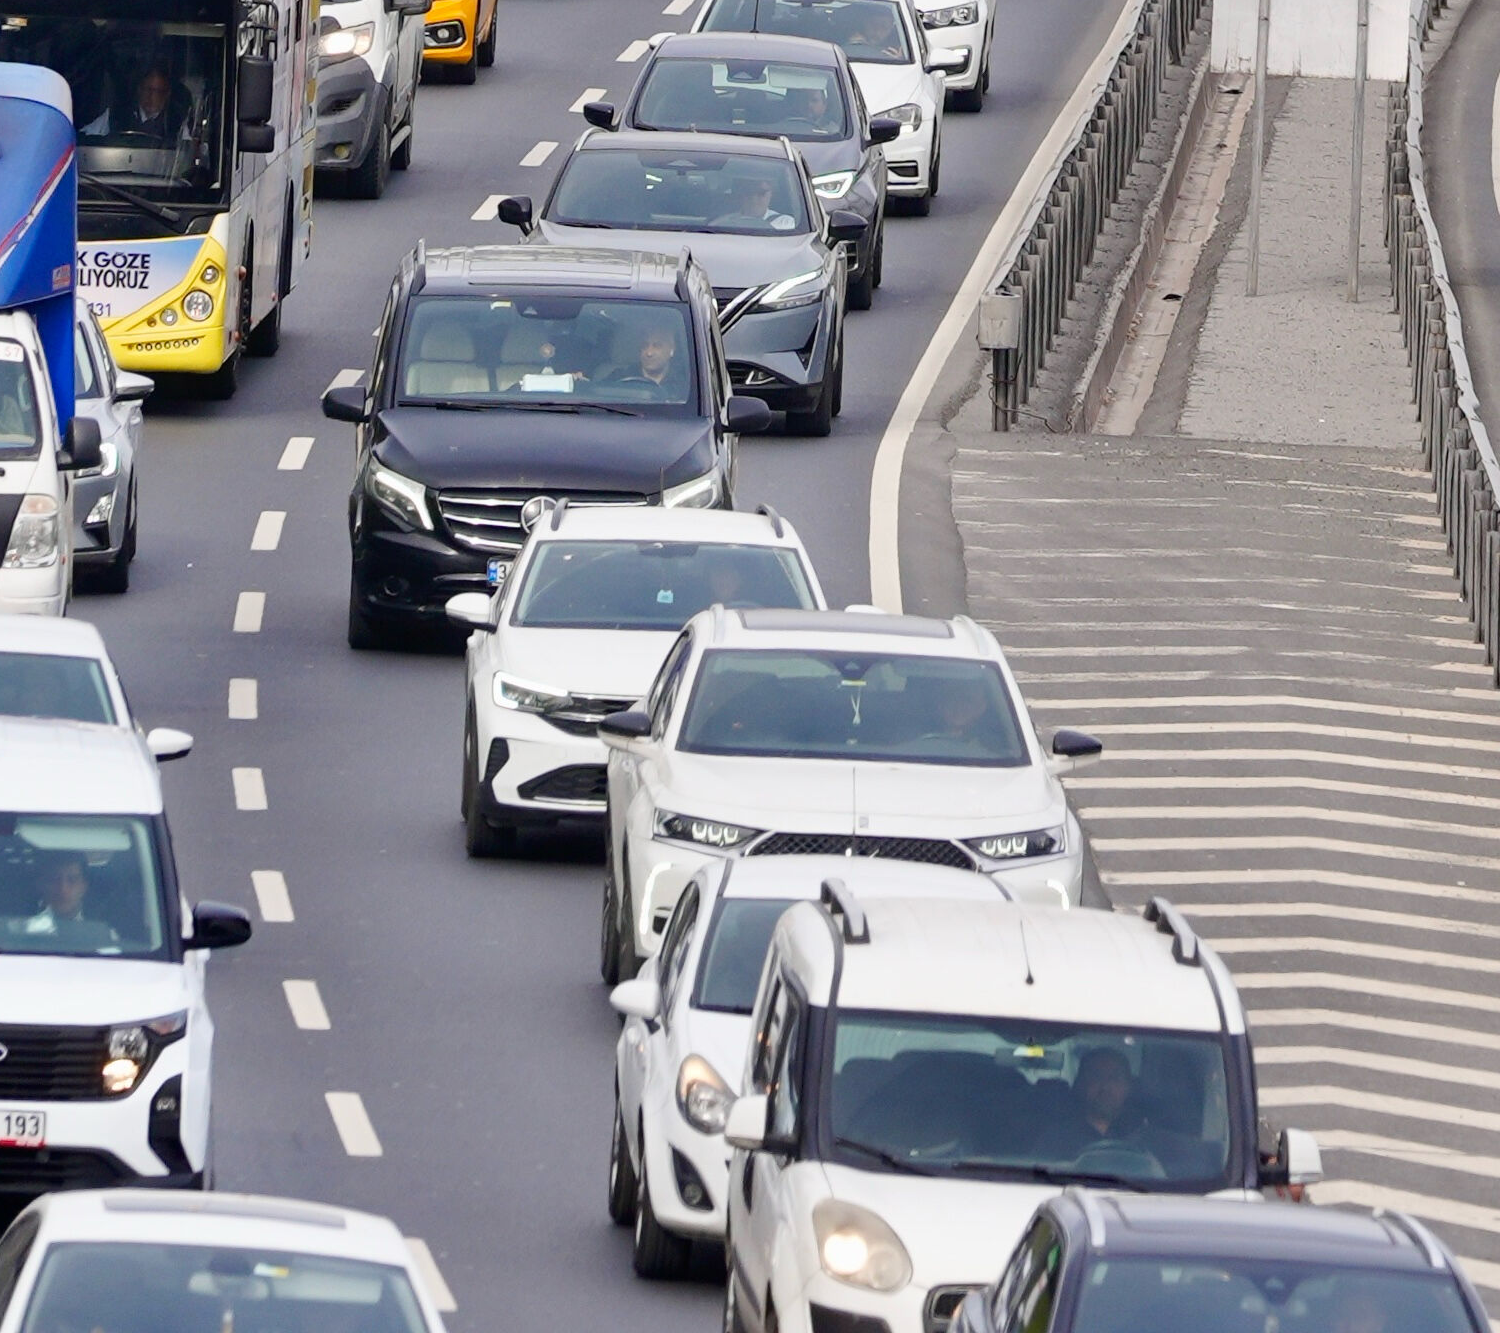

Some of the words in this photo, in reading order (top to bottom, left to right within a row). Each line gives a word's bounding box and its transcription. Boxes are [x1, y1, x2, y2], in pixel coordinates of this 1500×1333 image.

[94, 251, 151, 270] GÖZE
[3, 345, 21, 359] 57
[4, 1114, 40, 1137] 193
